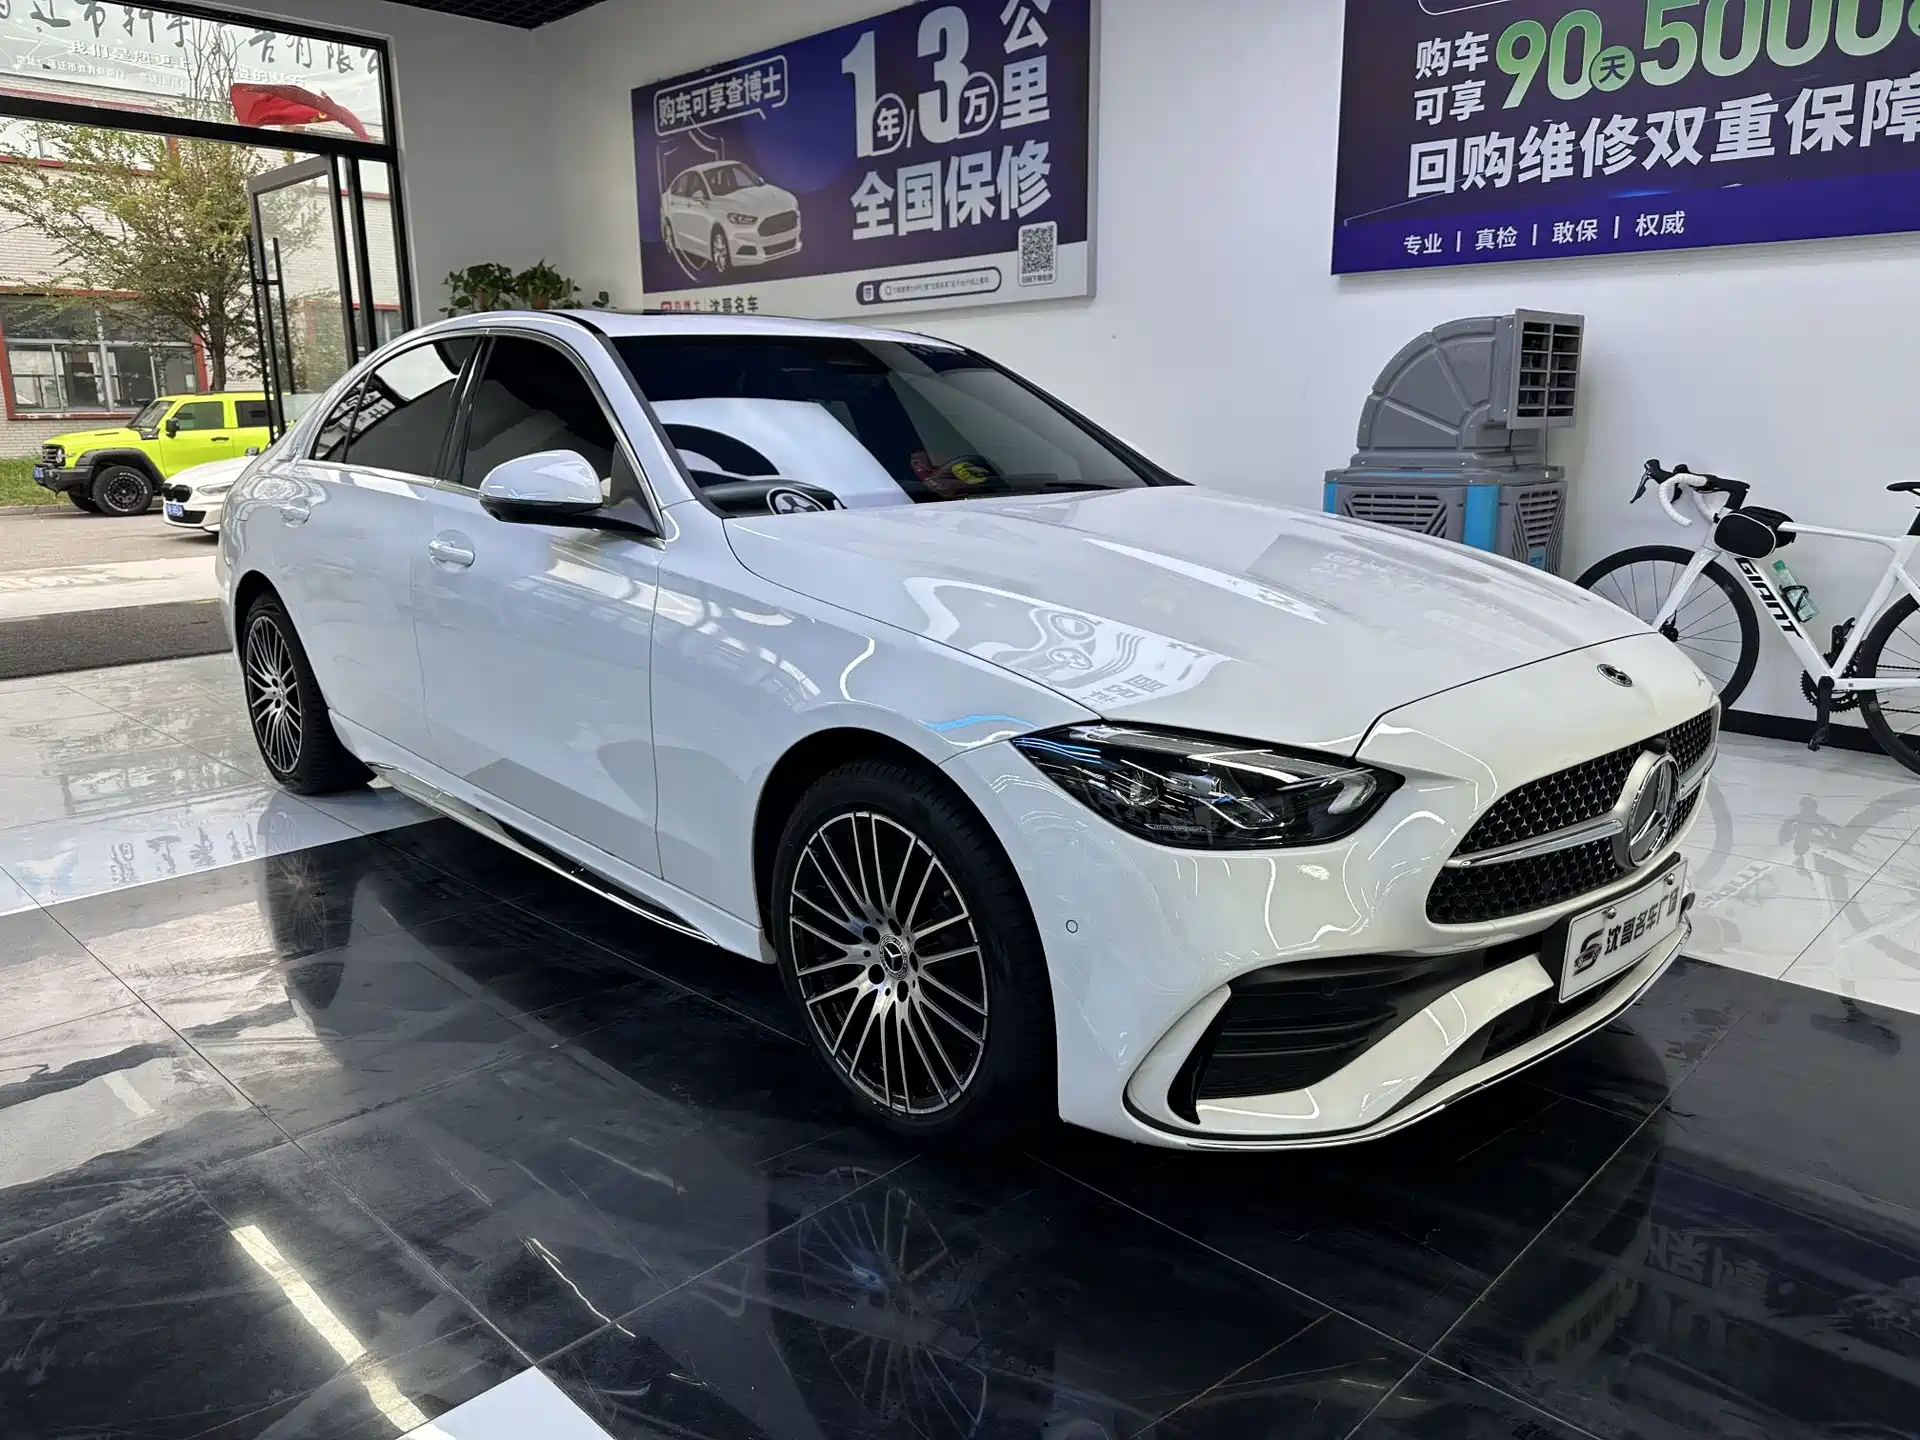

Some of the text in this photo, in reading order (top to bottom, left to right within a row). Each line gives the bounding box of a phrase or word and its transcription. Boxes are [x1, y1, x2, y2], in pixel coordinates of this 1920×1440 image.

[1415, 31, 1490, 80] 购车
[658, 66, 781, 127] 购车可享查博士
[1414, 79, 1486, 126] 可享
[1408, 70, 1920, 198] 回购维修双重保障
[851, 140, 1051, 240] 全国保修
[1403, 210, 1686, 256] 专业 真检 敢保 权威
[1734, 557, 1803, 640] GIANT
